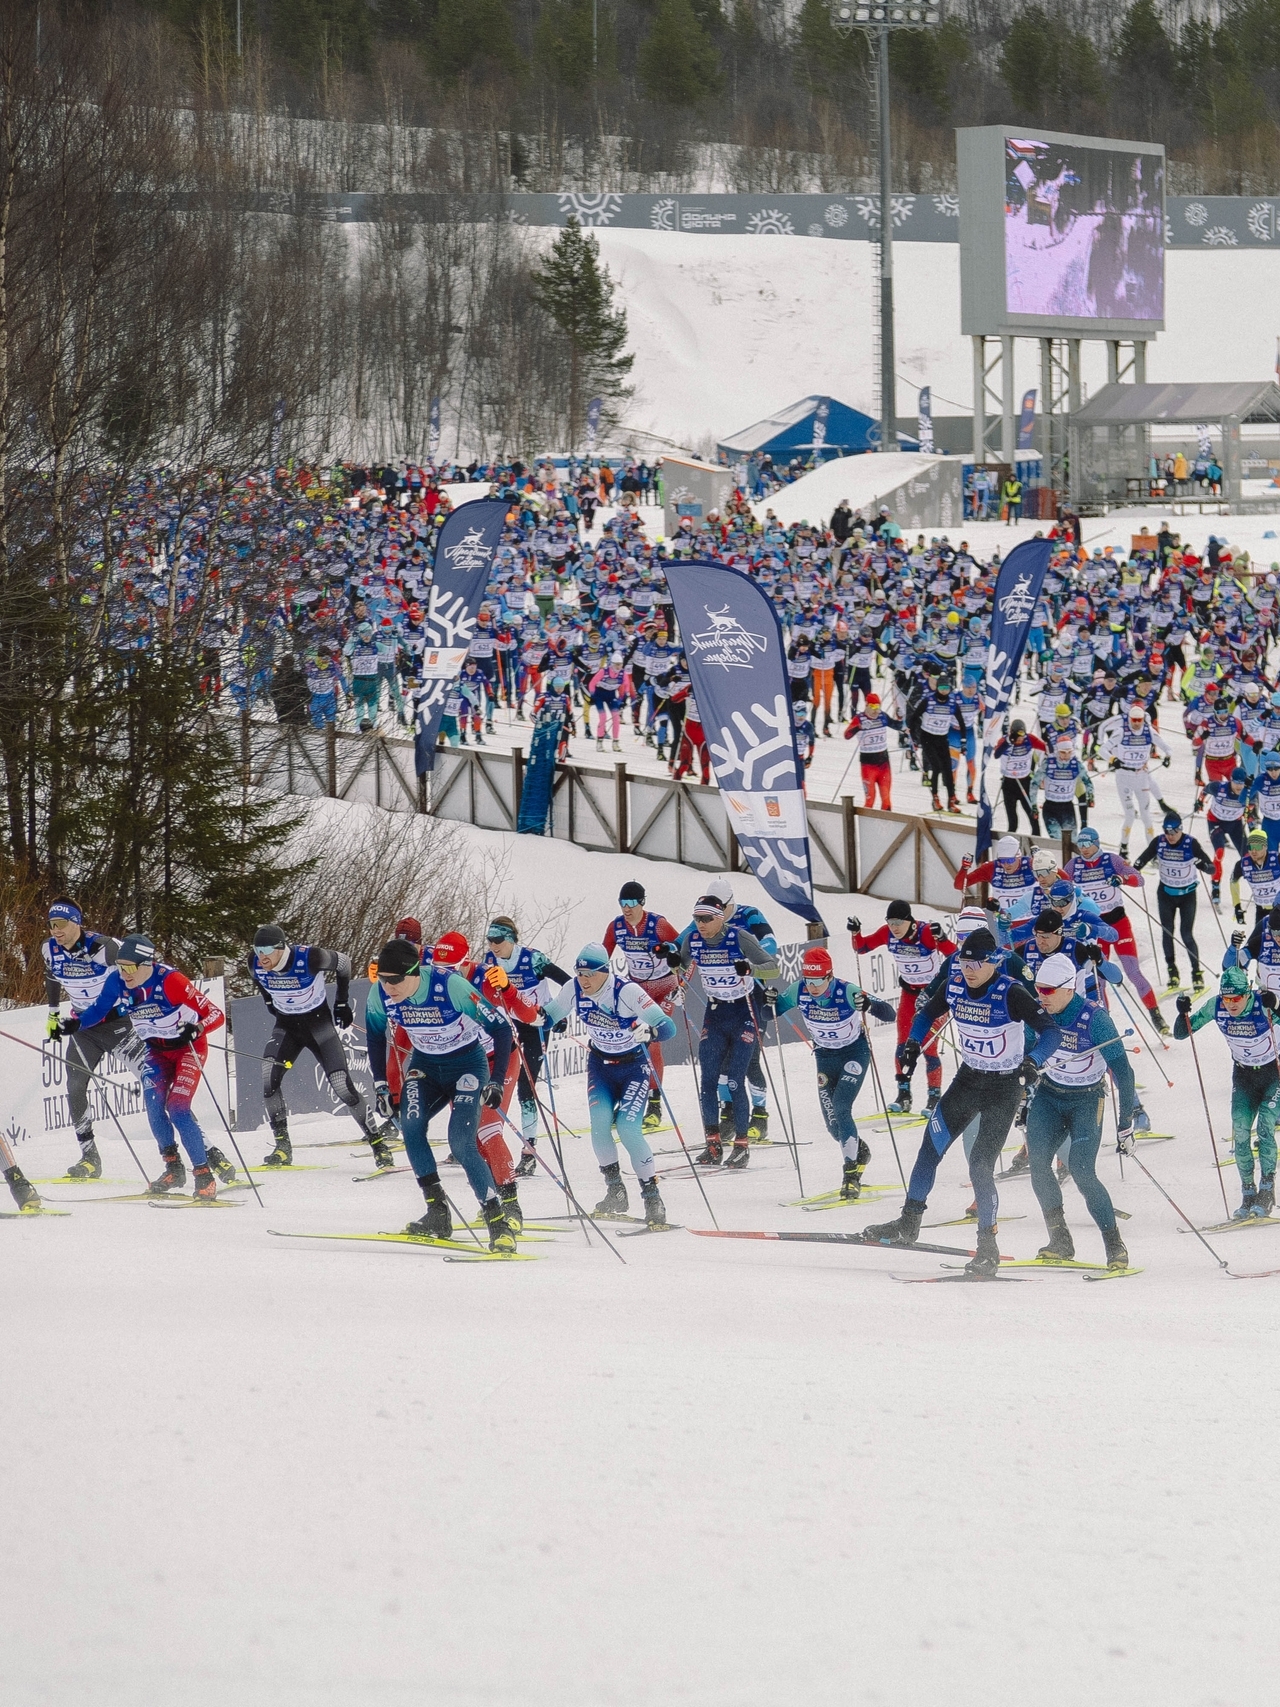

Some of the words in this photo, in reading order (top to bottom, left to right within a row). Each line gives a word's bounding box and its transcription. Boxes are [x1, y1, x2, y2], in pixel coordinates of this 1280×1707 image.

[1166, 868, 1182, 876] 151
[904, 964, 920, 973] 52
[871, 954, 885, 993] 50
[705, 976, 737, 985] 1342
[402, 1010, 441, 1018] ЛЫЖНЫЙ
[956, 1004, 990, 1016] ЛЫЖНЫЙ
[954, 1012, 990, 1024] МАРАФОН
[594, 1030, 623, 1040] 1496
[818, 1030, 838, 1039] 28
[41, 1038, 63, 1089] 50
[407, 1080, 420, 1119] КУЗБАСС
[406, 1235, 435, 1244] FISCHER
